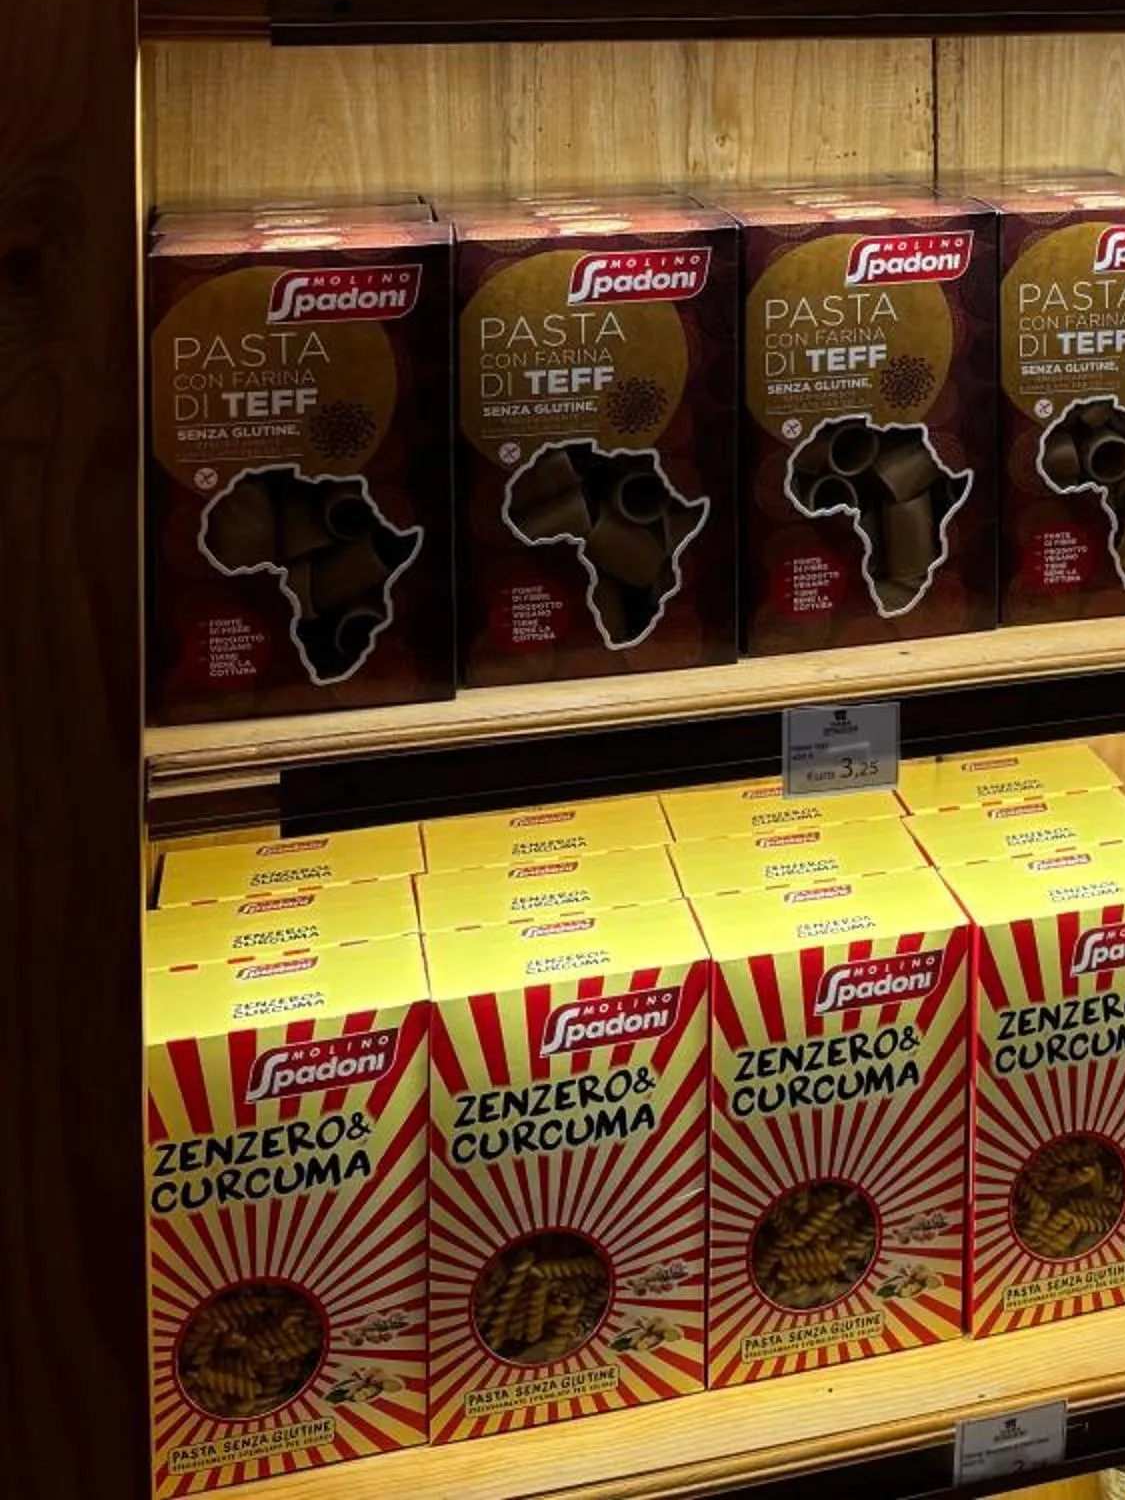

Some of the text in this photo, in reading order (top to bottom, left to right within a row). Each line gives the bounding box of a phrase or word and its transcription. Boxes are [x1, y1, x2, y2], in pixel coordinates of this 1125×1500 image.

[883, 238, 964, 251] MOLINO
[610, 254, 701, 269] MOLINO
[846, 243, 961, 283] Spadoni
[312, 272, 411, 287] MOLINO
[568, 259, 697, 304] Spadoni
[267, 276, 406, 322] Spadoni
[765, 291, 899, 330] PASTA
[480, 310, 627, 350] PASTA
[765, 326, 887, 350] CON FARINA
[1019, 315, 1060, 331] CON
[173, 330, 330, 370] PASTA
[480, 347, 614, 369] CON FARINA
[765, 344, 888, 377] DI TEFF
[1019, 333, 1048, 358] DI
[173, 368, 317, 392] CON FARINA
[480, 365, 615, 399] DI TEFF
[1021, 363, 1063, 376] SENZA
[174, 387, 318, 421] DI TEFF
[767, 381, 811, 395] SENZA
[483, 402, 531, 417] SENZA
[177, 426, 228, 441] SENZA
[839, 756, 880, 779] 3,25
[853, 955, 936, 977] MOLINO
[582, 993, 673, 1017] MOLINO
[814, 968, 932, 1015] Spadoni
[291, 1035, 390, 1061] MOLINO
[540, 1007, 669, 1057] Spadoni
[246, 1052, 386, 1102] Spadoni
[732, 1060, 920, 1117] CURCUMA
[451, 1102, 655, 1164] CURCUMA
[151, 1149, 372, 1214] CURCUMA
[1005, 1282, 1042, 1301] PASTA
[1046, 1273, 1084, 1292] SENZA
[743, 1313, 883, 1351] PASTA SENZA GLUTINE
[467, 1367, 618, 1407] PASTA SENZA GLUTINE
[173, 1420, 332, 1463] PASTA SENZA GLUTINE
